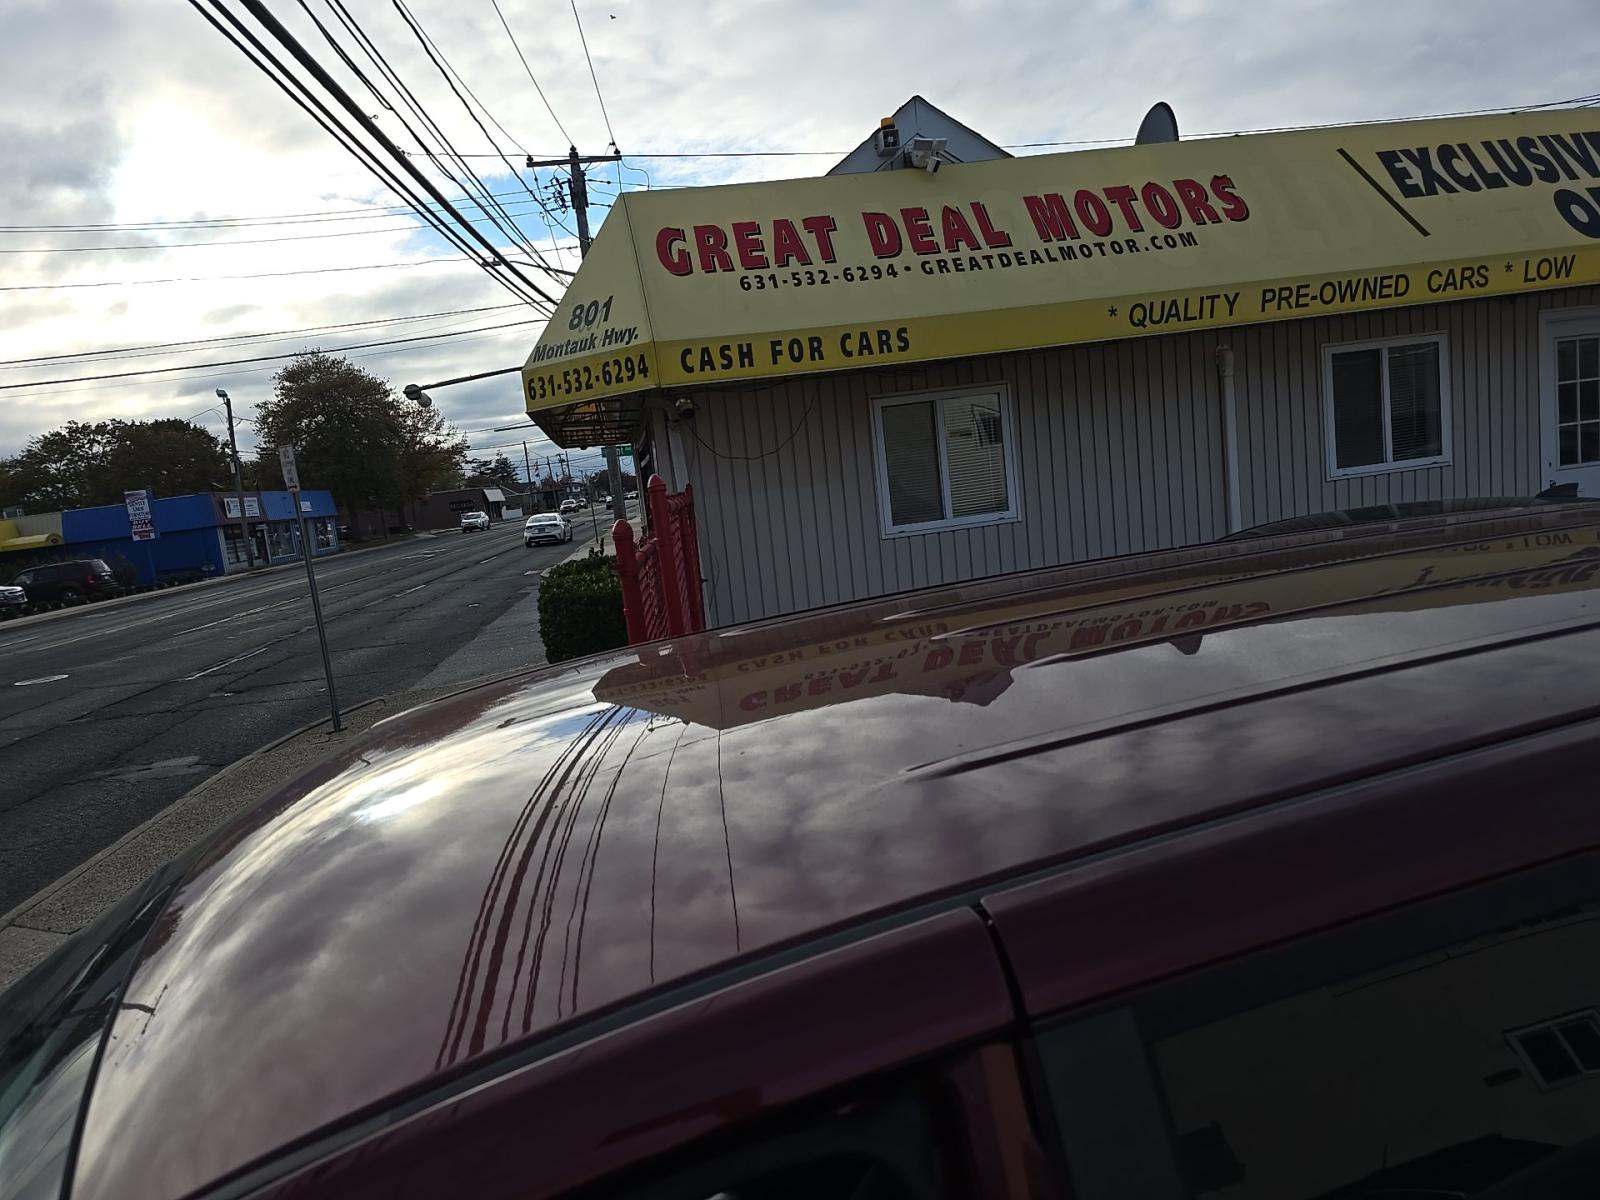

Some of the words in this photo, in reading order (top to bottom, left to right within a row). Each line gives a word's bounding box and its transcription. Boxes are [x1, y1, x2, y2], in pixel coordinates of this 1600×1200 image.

[655, 215, 838, 277] GREAT
[861, 201, 1013, 260] DEAL
[1022, 174, 1251, 243] MOTORS
[739, 263, 900, 292] 631-532-6294
[920, 231, 1199, 276] GREATDEALMOTOR.COM
[568, 295, 614, 331] 801
[1128, 292, 1241, 329] QUALITY
[1260, 273, 1410, 314] PRE-OWNED
[1426, 264, 1490, 294] CARS
[1523, 254, 1577, 283] LOW
[532, 332, 598, 363] Montauk
[601, 326, 639, 346] Hwy.
[680, 342, 754, 374] CASH
[770, 335, 824, 366] FOR
[839, 327, 911, 357] CARS
[527, 353, 649, 401] 631-532-6294
